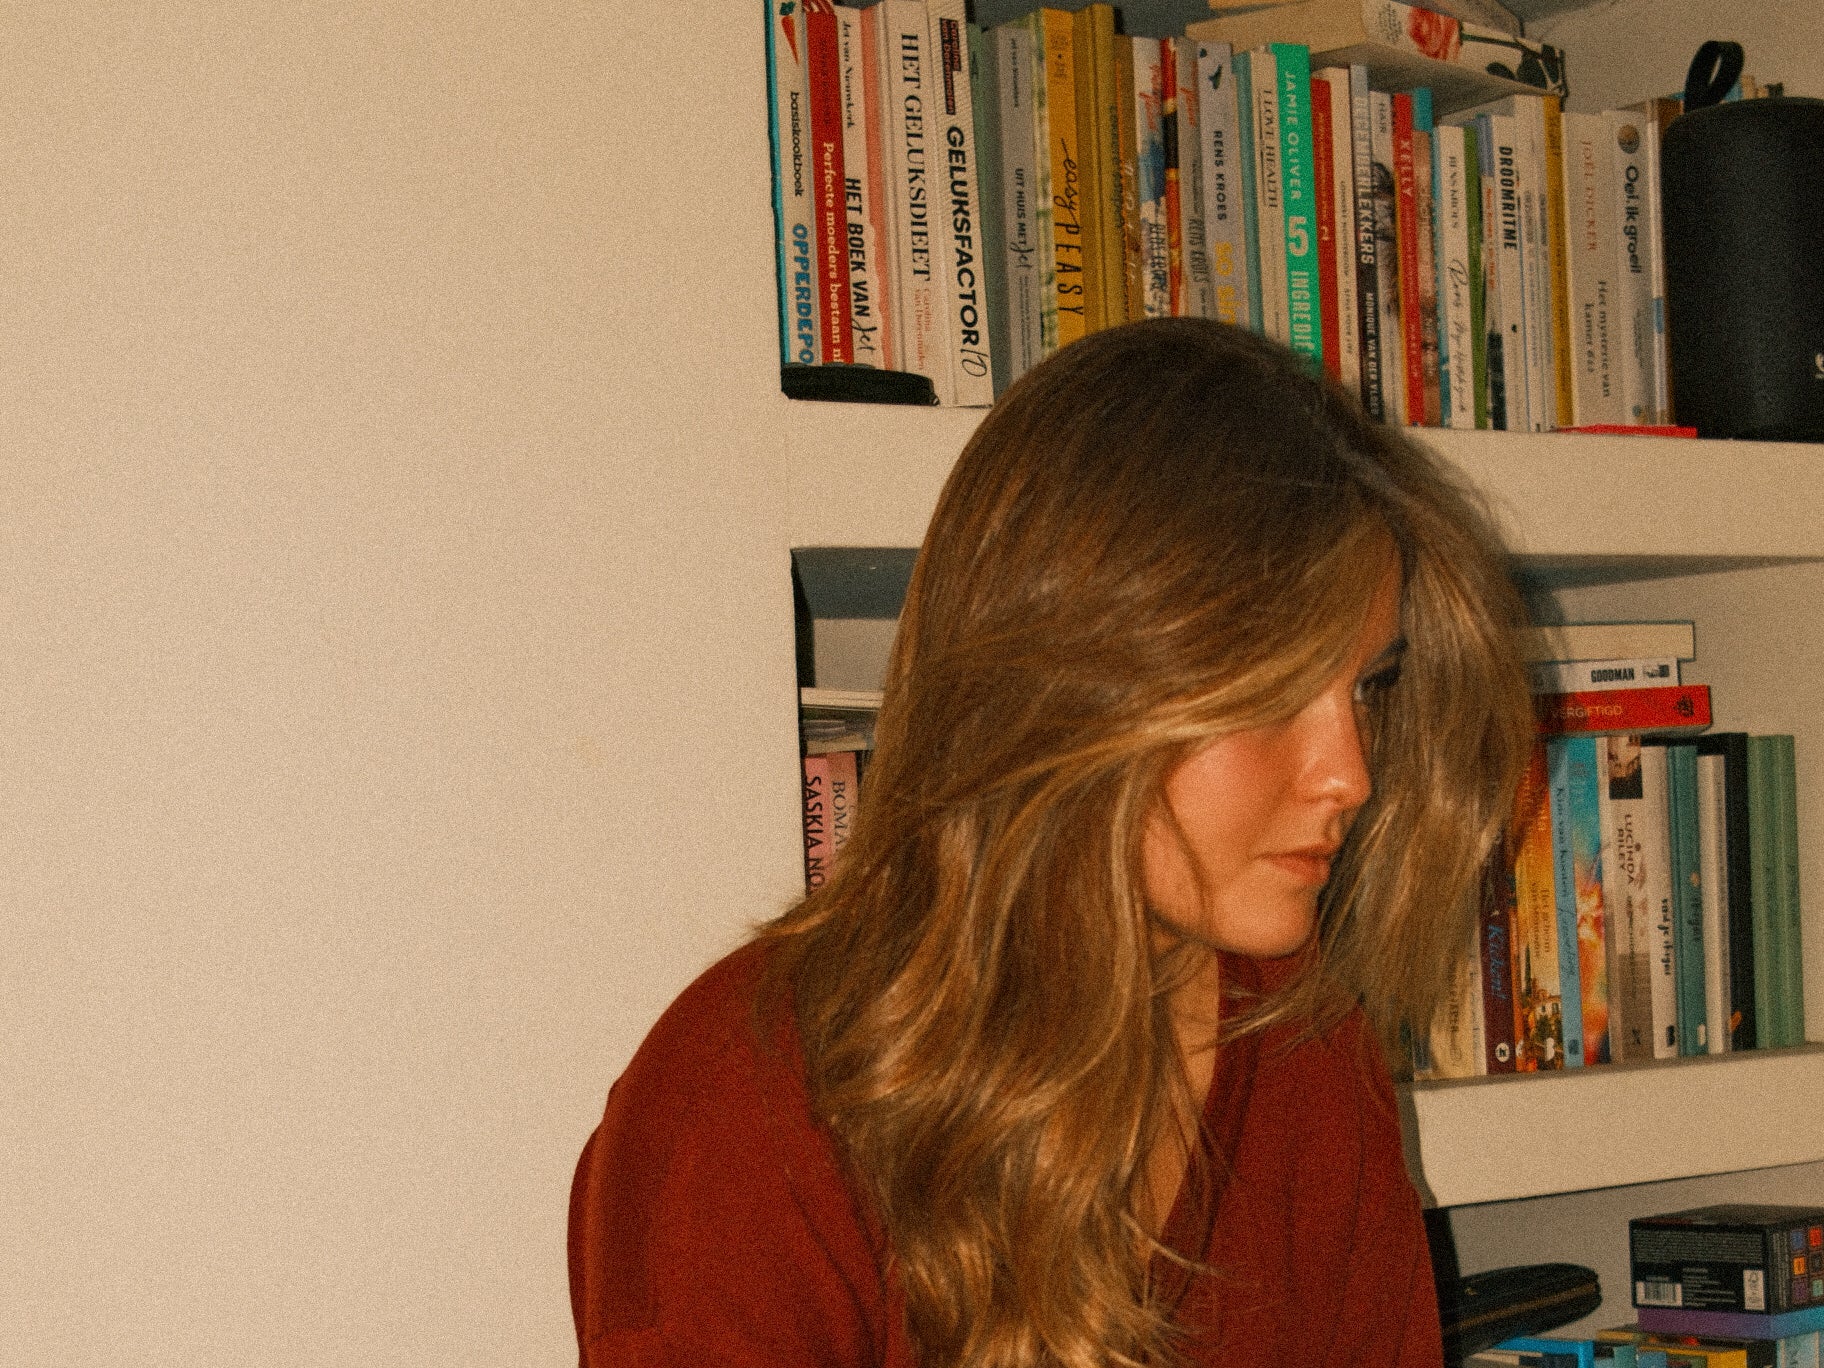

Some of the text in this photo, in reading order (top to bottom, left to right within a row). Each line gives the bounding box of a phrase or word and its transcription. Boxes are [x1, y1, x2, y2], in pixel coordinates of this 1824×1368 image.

[844, 42, 852, 62] van
[790, 92, 804, 198] basiskookboek
[1264, 99, 1276, 141] LOVE
[1285, 71, 1302, 201] JAMIE OLIVER
[1378, 102, 1388, 134] HAIR
[823, 142, 839, 208] Perfecte
[900, 33, 932, 282] HET GELUKSDIEET
[1015, 168, 1025, 187] UIT
[1053, 150, 1079, 213] easy
[1213, 130, 1228, 221] RENS KROES
[1266, 145, 1279, 209] HEALTH
[1354, 97, 1375, 265] DECEMBERLEKKERS
[1016, 190, 1026, 219] HUIS
[1499, 146, 1518, 250] DROOMRITME
[1585, 187, 1598, 251] DICKER
[826, 212, 842, 279] moeders
[846, 178, 878, 351] HET BOEK VAN Jet
[946, 126, 981, 346] GELUKSFACTOR
[1017, 222, 1028, 246] MET
[1288, 216, 1310, 257] 5
[1055, 220, 1084, 316] PEASY
[830, 283, 844, 344] bestaan
[1365, 293, 1376, 336] MONIQUE
[1584, 303, 1595, 346] kamer
[1597, 280, 1611, 397] Het mysterie van
[1367, 339, 1377, 358] VAN
[1368, 361, 1378, 381] DER
[1591, 667, 1635, 684] GOODMAN
[804, 776, 825, 850] SASKIA
[1557, 787, 1565, 815] Kim
[1558, 821, 1566, 844] van
[1618, 828, 1627, 872] RILEY
[1624, 814, 1636, 885] LUCINDA
[1560, 850, 1570, 898] Kooten
